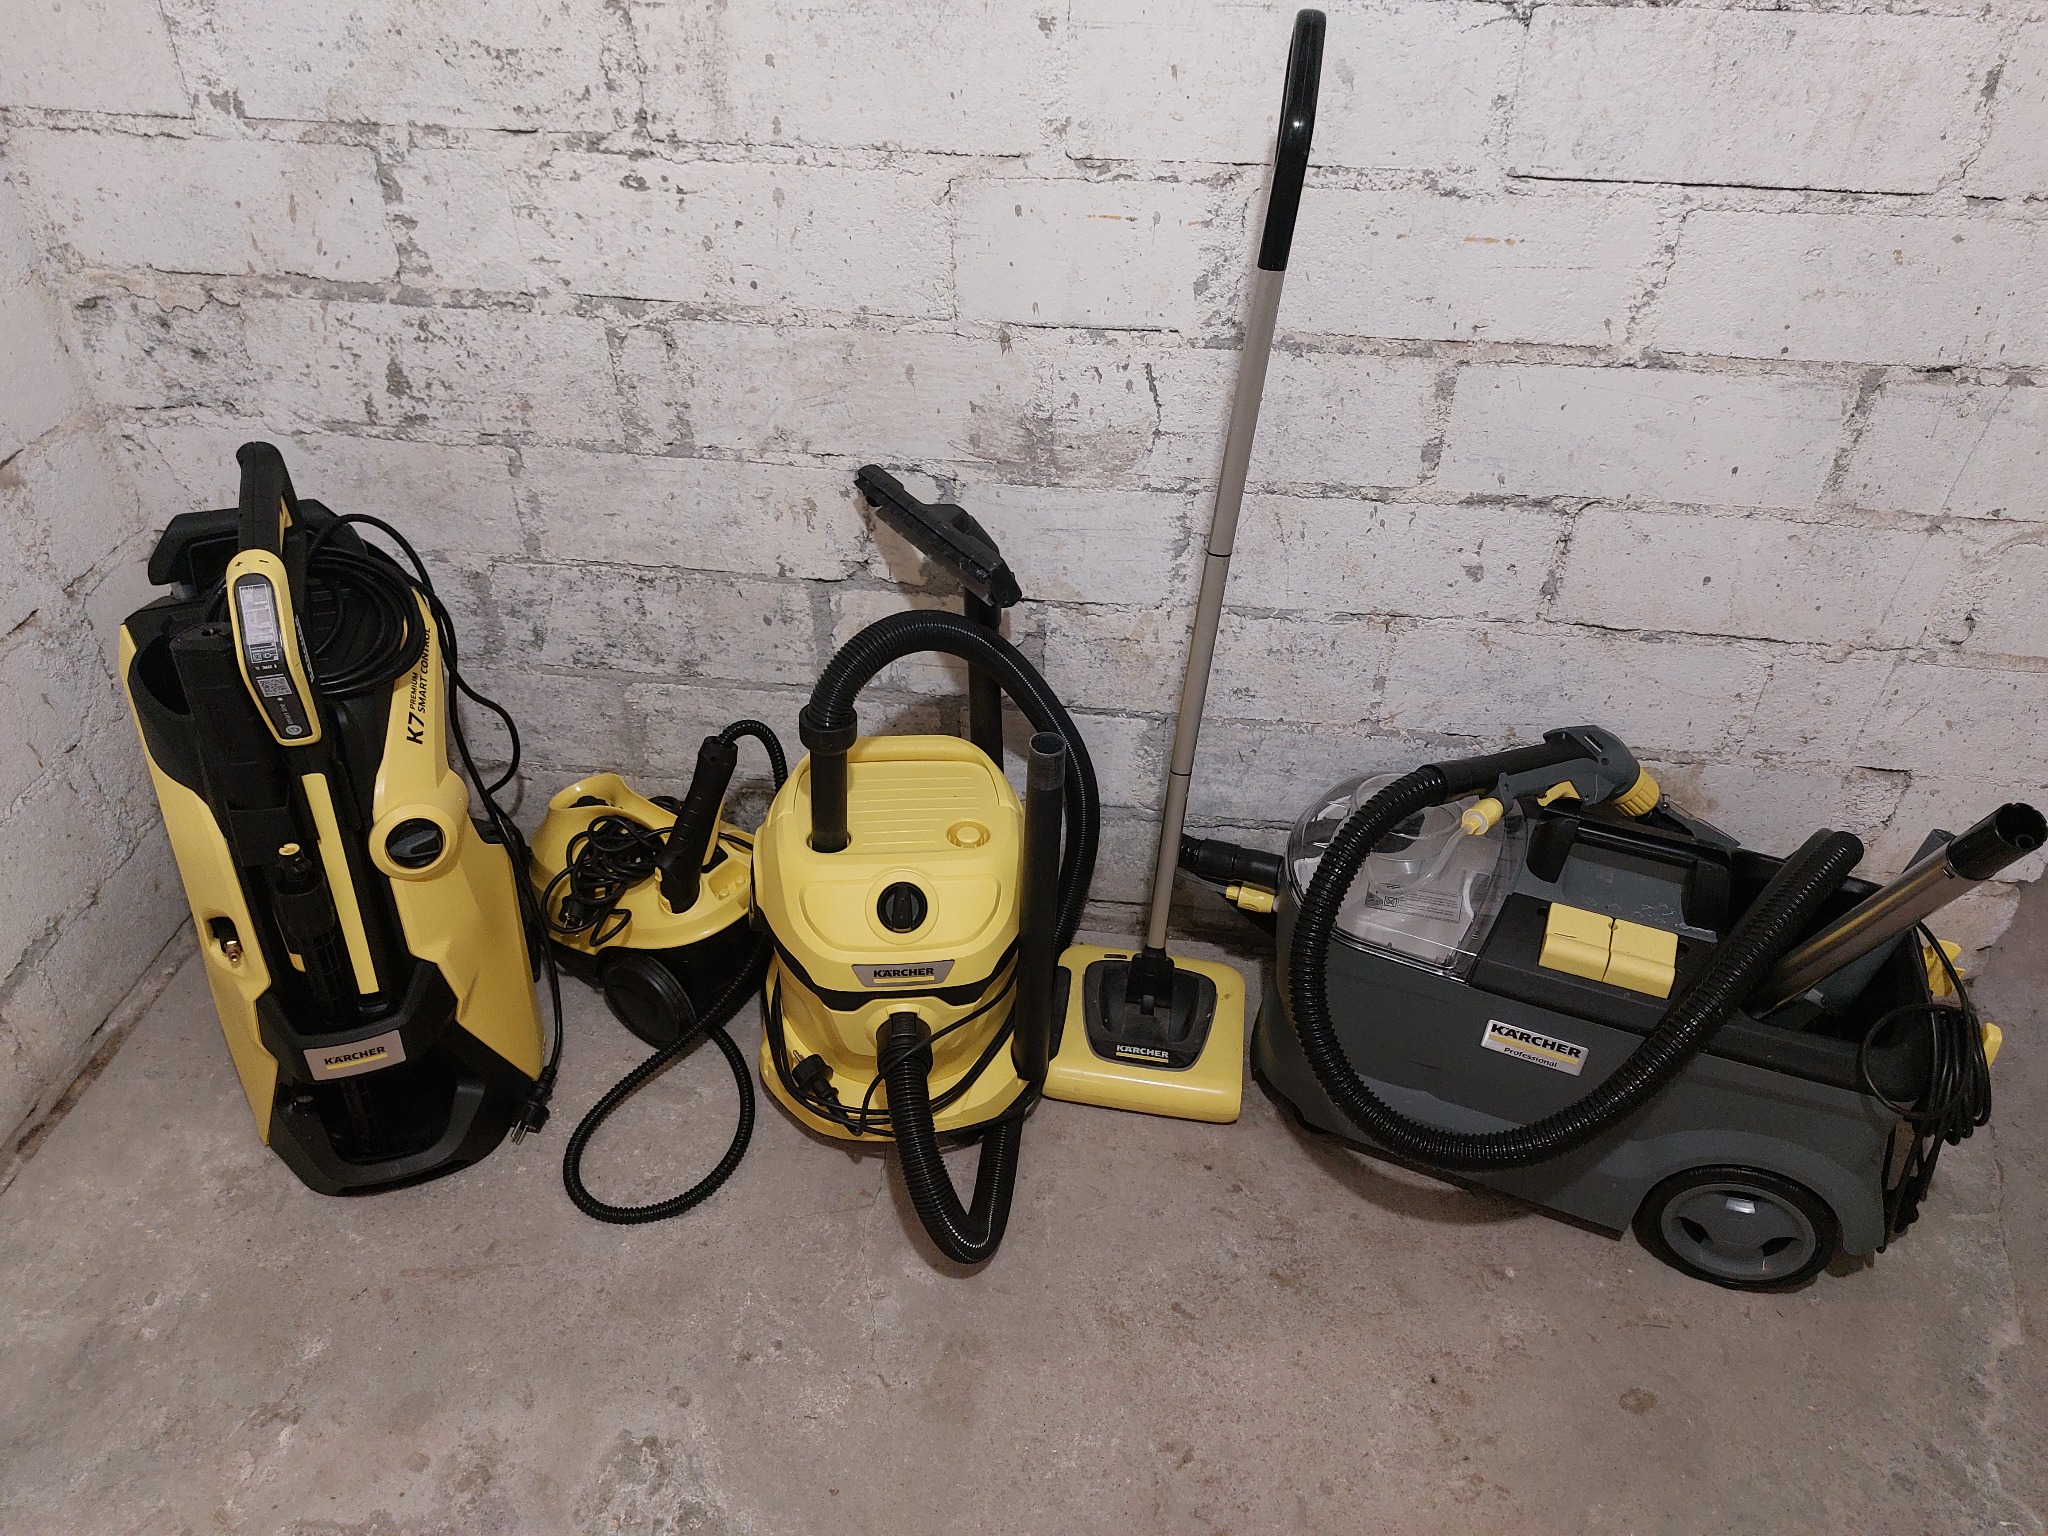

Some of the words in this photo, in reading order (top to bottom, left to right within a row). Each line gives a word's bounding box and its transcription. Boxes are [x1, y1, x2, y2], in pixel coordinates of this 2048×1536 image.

[409, 672, 419, 710] PREMIUM
[417, 675, 428, 713] SMART
[406, 711, 425, 745] K7
[873, 967, 935, 977] KÄRCHER
[1116, 1044, 1169, 1058] KÄRCHER
[1491, 1024, 1582, 1058] KÄRCHER
[324, 1046, 386, 1065] KÄRCHER
[1503, 1047, 1558, 1068] Professional
